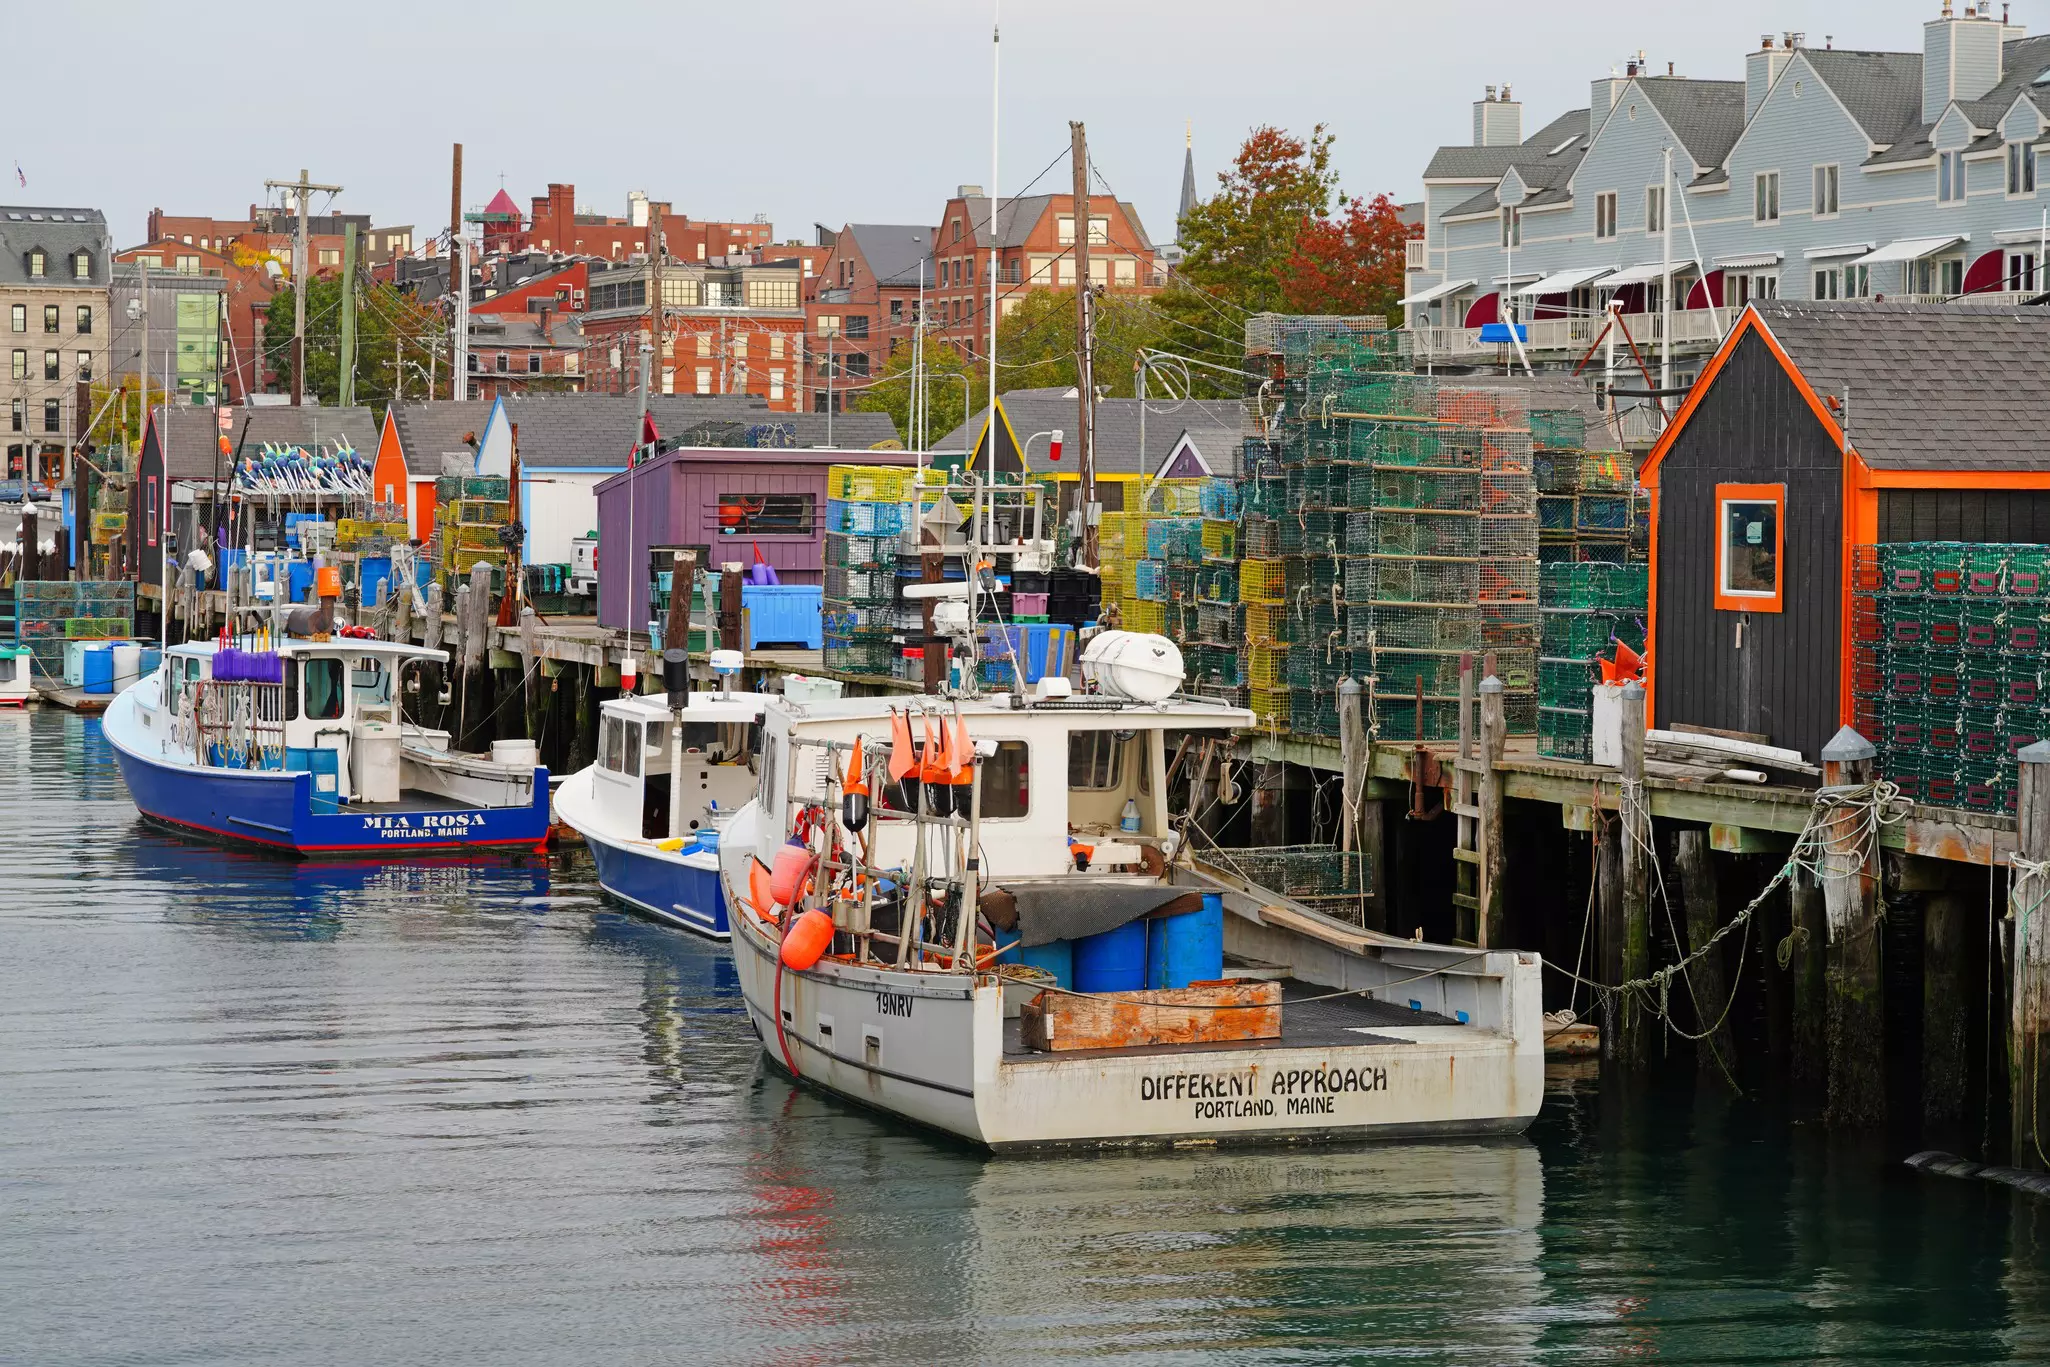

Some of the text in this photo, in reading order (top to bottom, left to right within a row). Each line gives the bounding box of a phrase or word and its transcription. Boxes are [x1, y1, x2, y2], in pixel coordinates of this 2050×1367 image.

[362, 813, 487, 829] MIA ROSA
[437, 826, 469, 837] MAINE
[876, 992, 914, 1018] 19NRV
[1141, 1067, 1388, 1101] DIFFERENT APPROACH
[1286, 1096, 1335, 1116] MAINE
